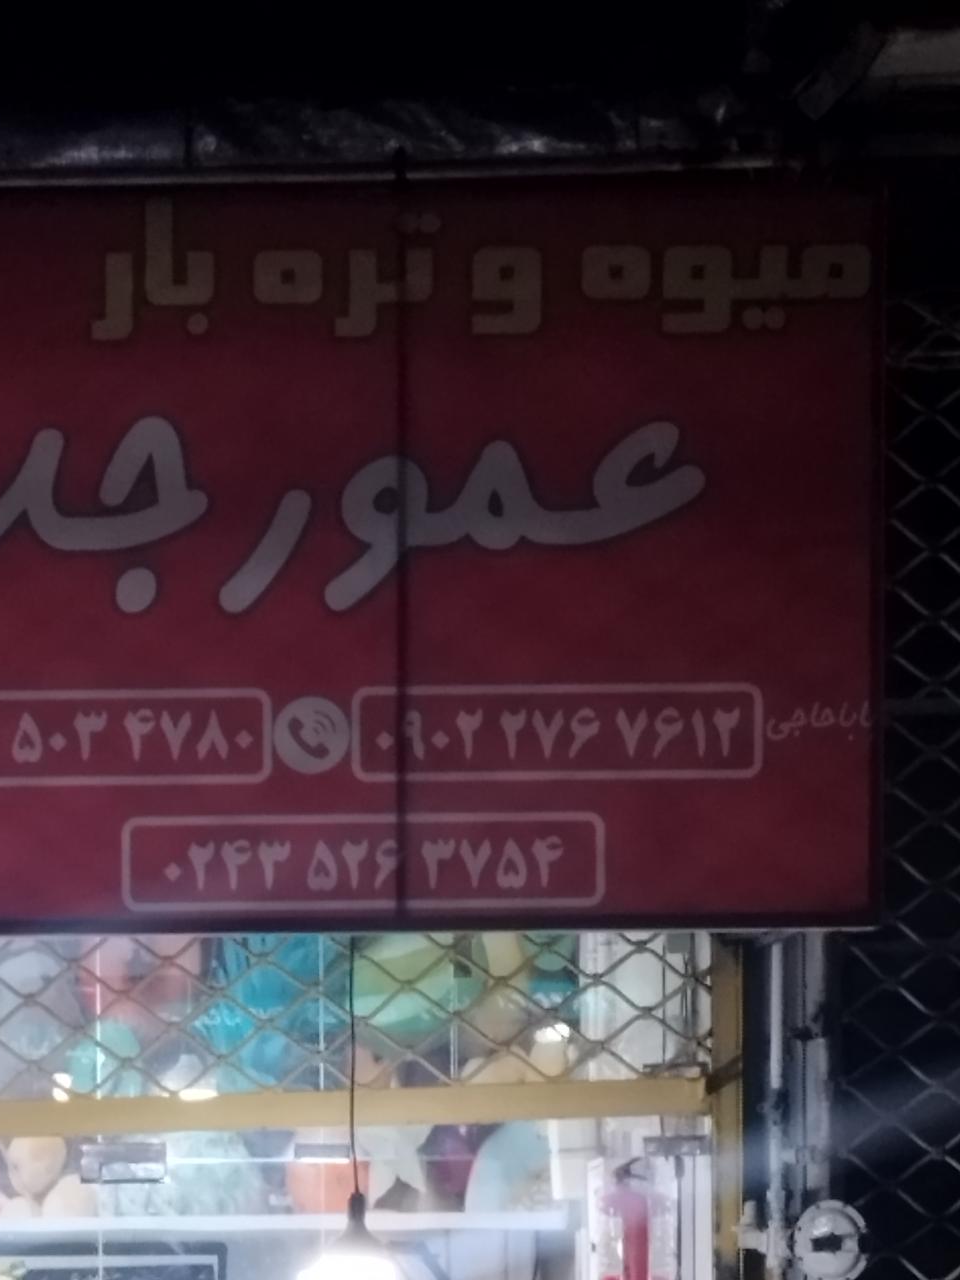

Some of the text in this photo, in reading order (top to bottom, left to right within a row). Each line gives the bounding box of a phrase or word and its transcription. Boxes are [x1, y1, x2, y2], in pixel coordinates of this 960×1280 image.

[91, 199, 872, 340] میوه و تره بار
[12, 710, 107, 763] ۵۰۳
[123, 708, 254, 762] ۴۷۸۰
[375, 706, 741, 760] ۰۹۰۲ ۲۷۶ ۷۶۱۲
[163, 836, 565, 891] ۰۲۴۳ ۵۲۶ ۳۷۵۴
